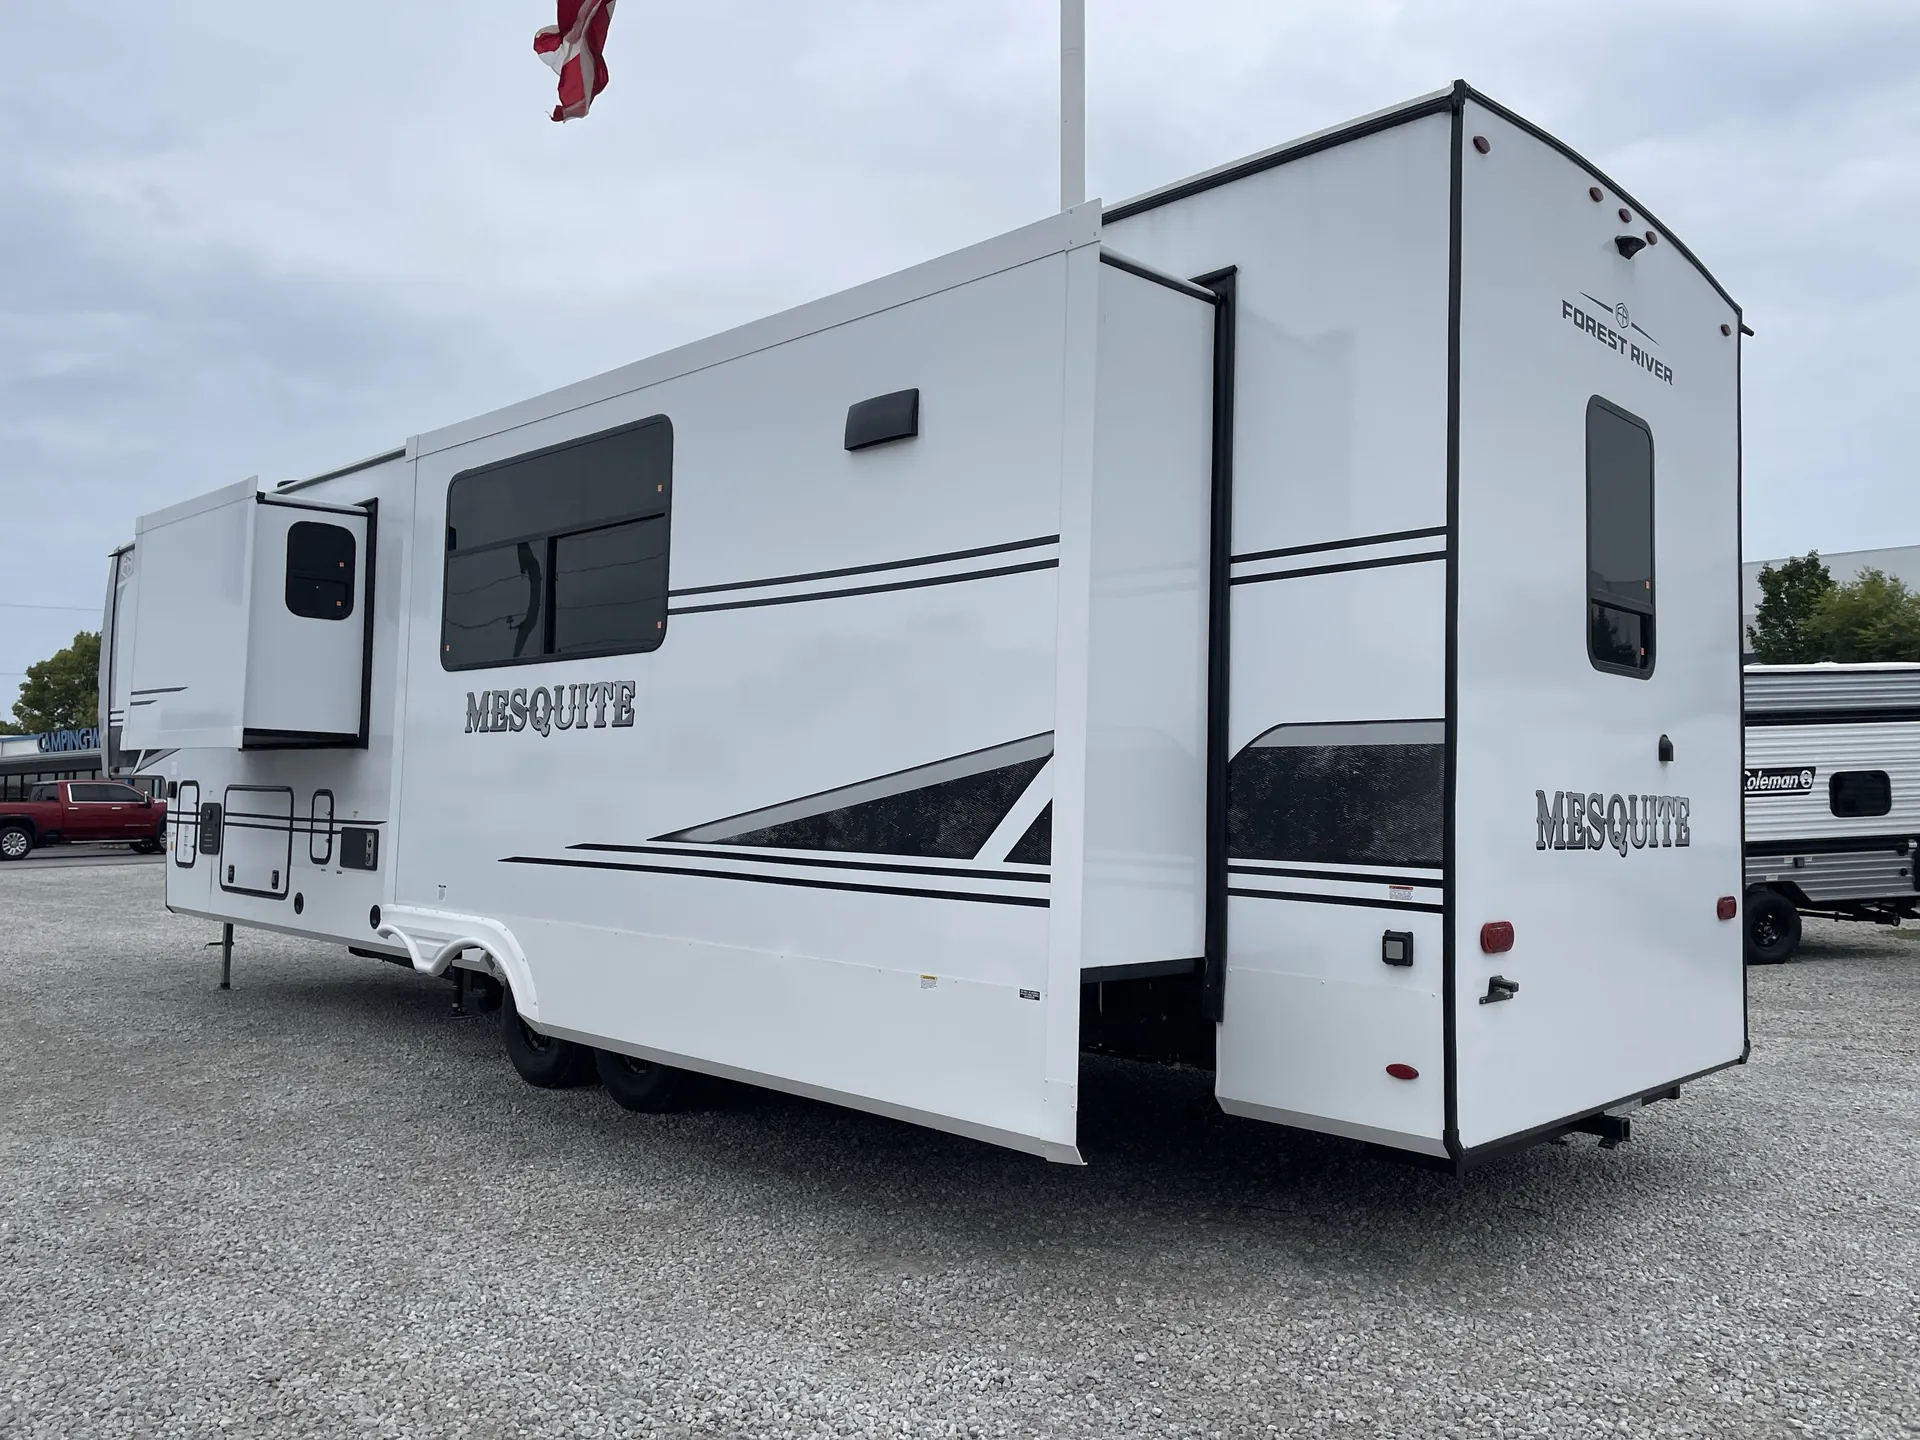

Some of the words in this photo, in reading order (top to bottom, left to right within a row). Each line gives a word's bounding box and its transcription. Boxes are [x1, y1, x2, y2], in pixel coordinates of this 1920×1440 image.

[1562, 299, 1627, 355] FOREST
[1630, 343, 1673, 386] RIVER
[464, 680, 636, 738] MESQUITE
[37, 730, 89, 753] CAMPING
[1535, 789, 1690, 858] MESQUITE
